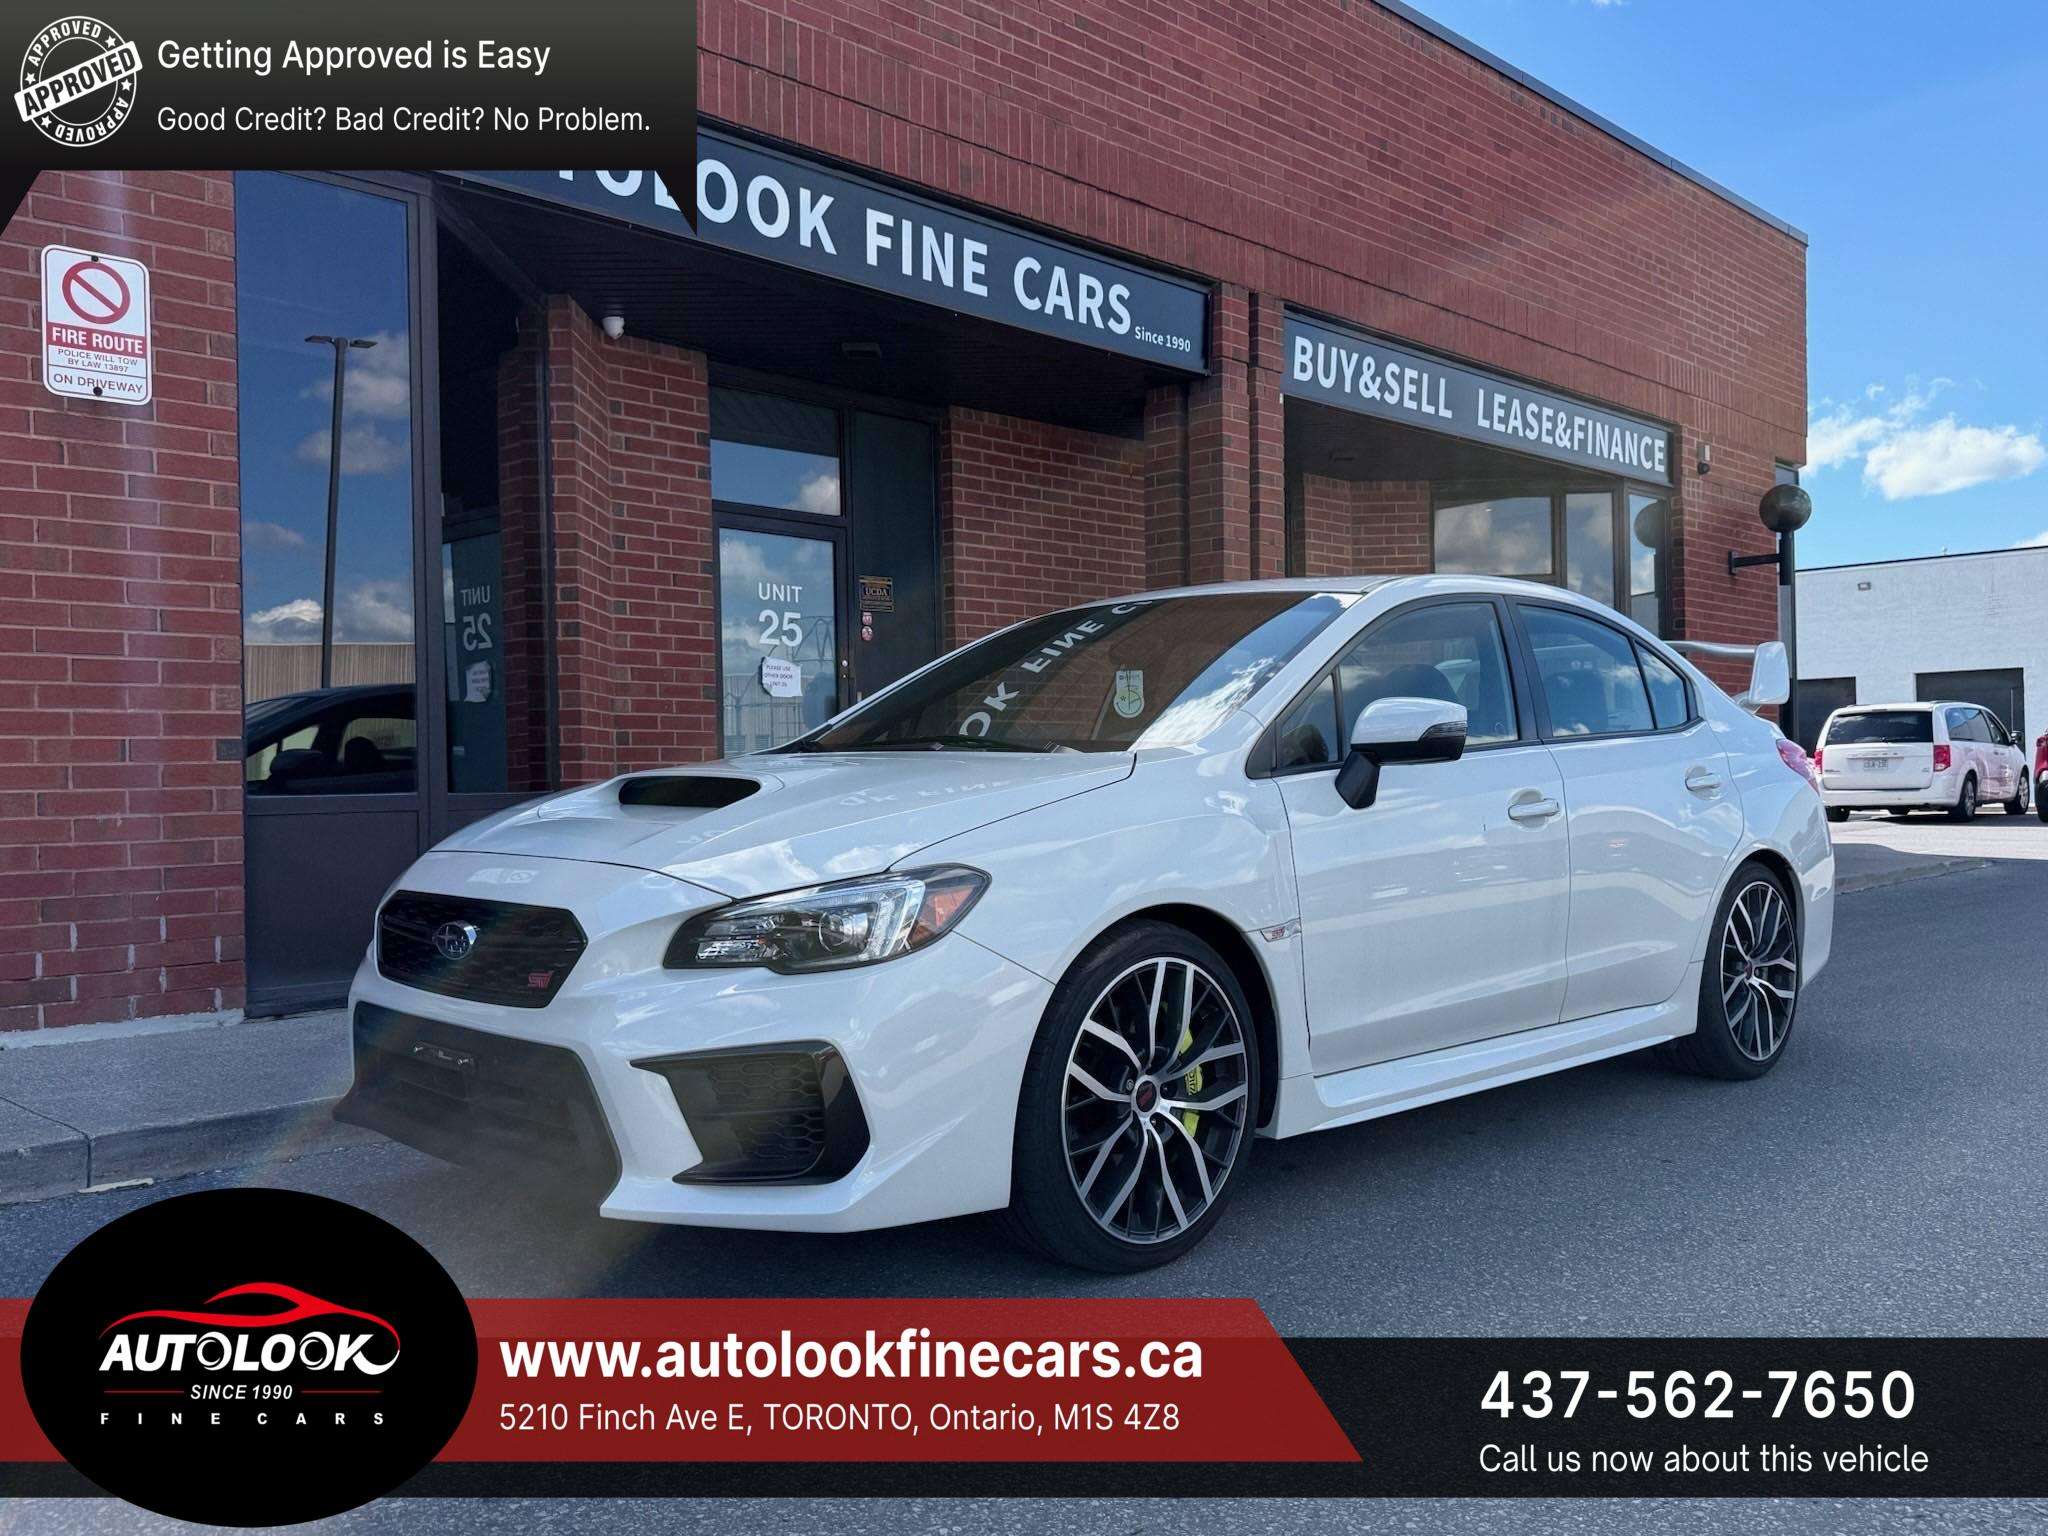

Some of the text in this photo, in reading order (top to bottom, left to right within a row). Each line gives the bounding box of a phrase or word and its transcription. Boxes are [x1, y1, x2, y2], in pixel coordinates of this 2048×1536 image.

[866, 207, 988, 297] FINE
[1013, 256, 1131, 336] CARS
[52, 326, 144, 354] FIRE ROUTE
[1134, 325, 1191, 354] Since 1990
[57, 348, 138, 366] POLICE WILL TOW
[67, 357, 129, 373] BY LAW 13897
[53, 373, 143, 394] ON DRIVEWAY
[1292, 335, 1665, 474] BUY&SELL LEASE&FINANCE
[758, 582, 803, 604] UNIT
[757, 608, 803, 647] 25
